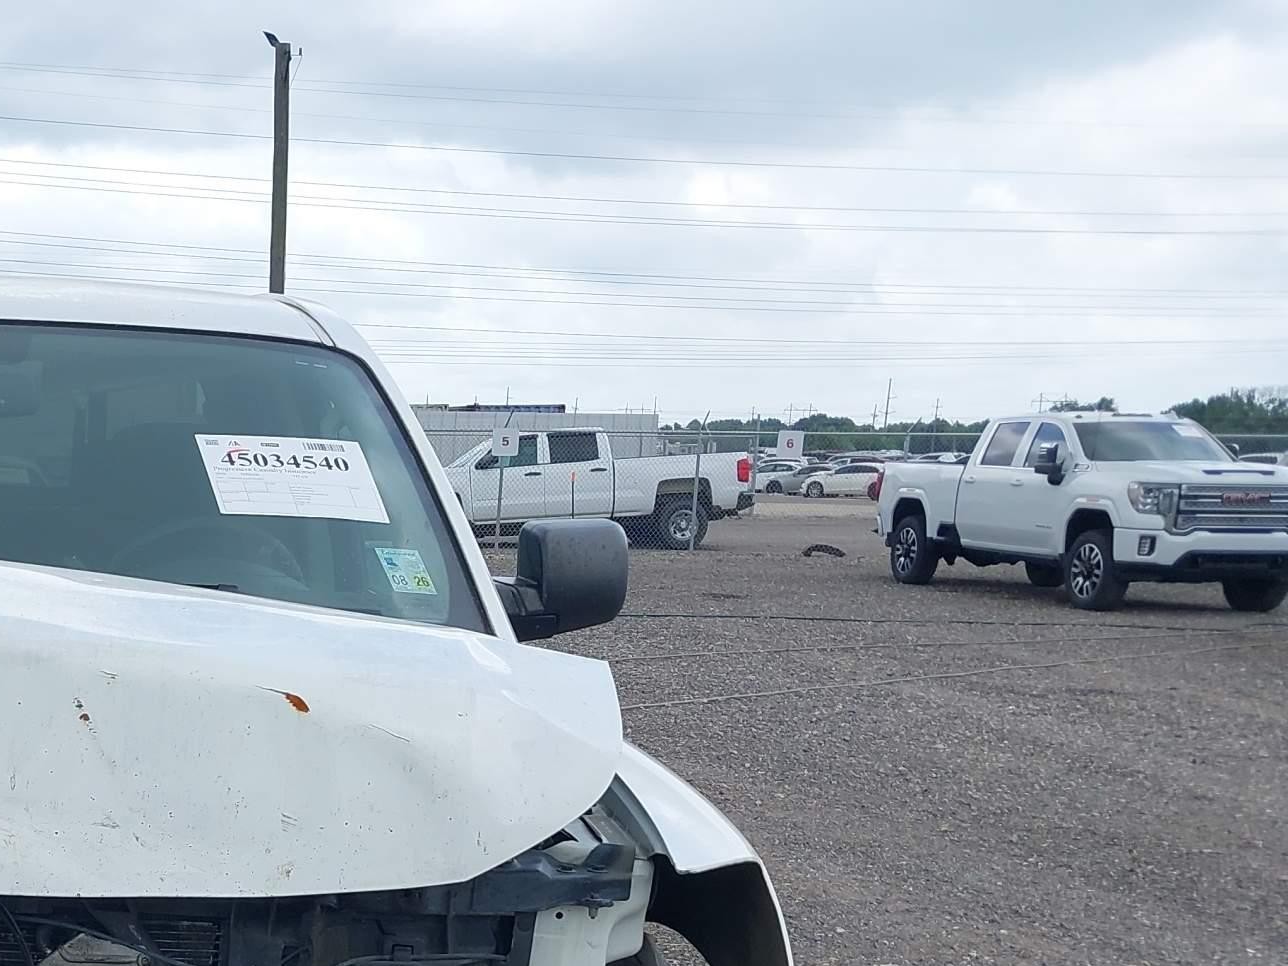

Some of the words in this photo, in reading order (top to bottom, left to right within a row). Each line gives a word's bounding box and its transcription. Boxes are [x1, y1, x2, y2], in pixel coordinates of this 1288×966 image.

[501, 436, 510, 447] 5
[786, 438, 794, 449] 6
[220, 452, 350, 472] 45034540
[391, 574, 409, 586] 08
[413, 575, 431, 587] 26
